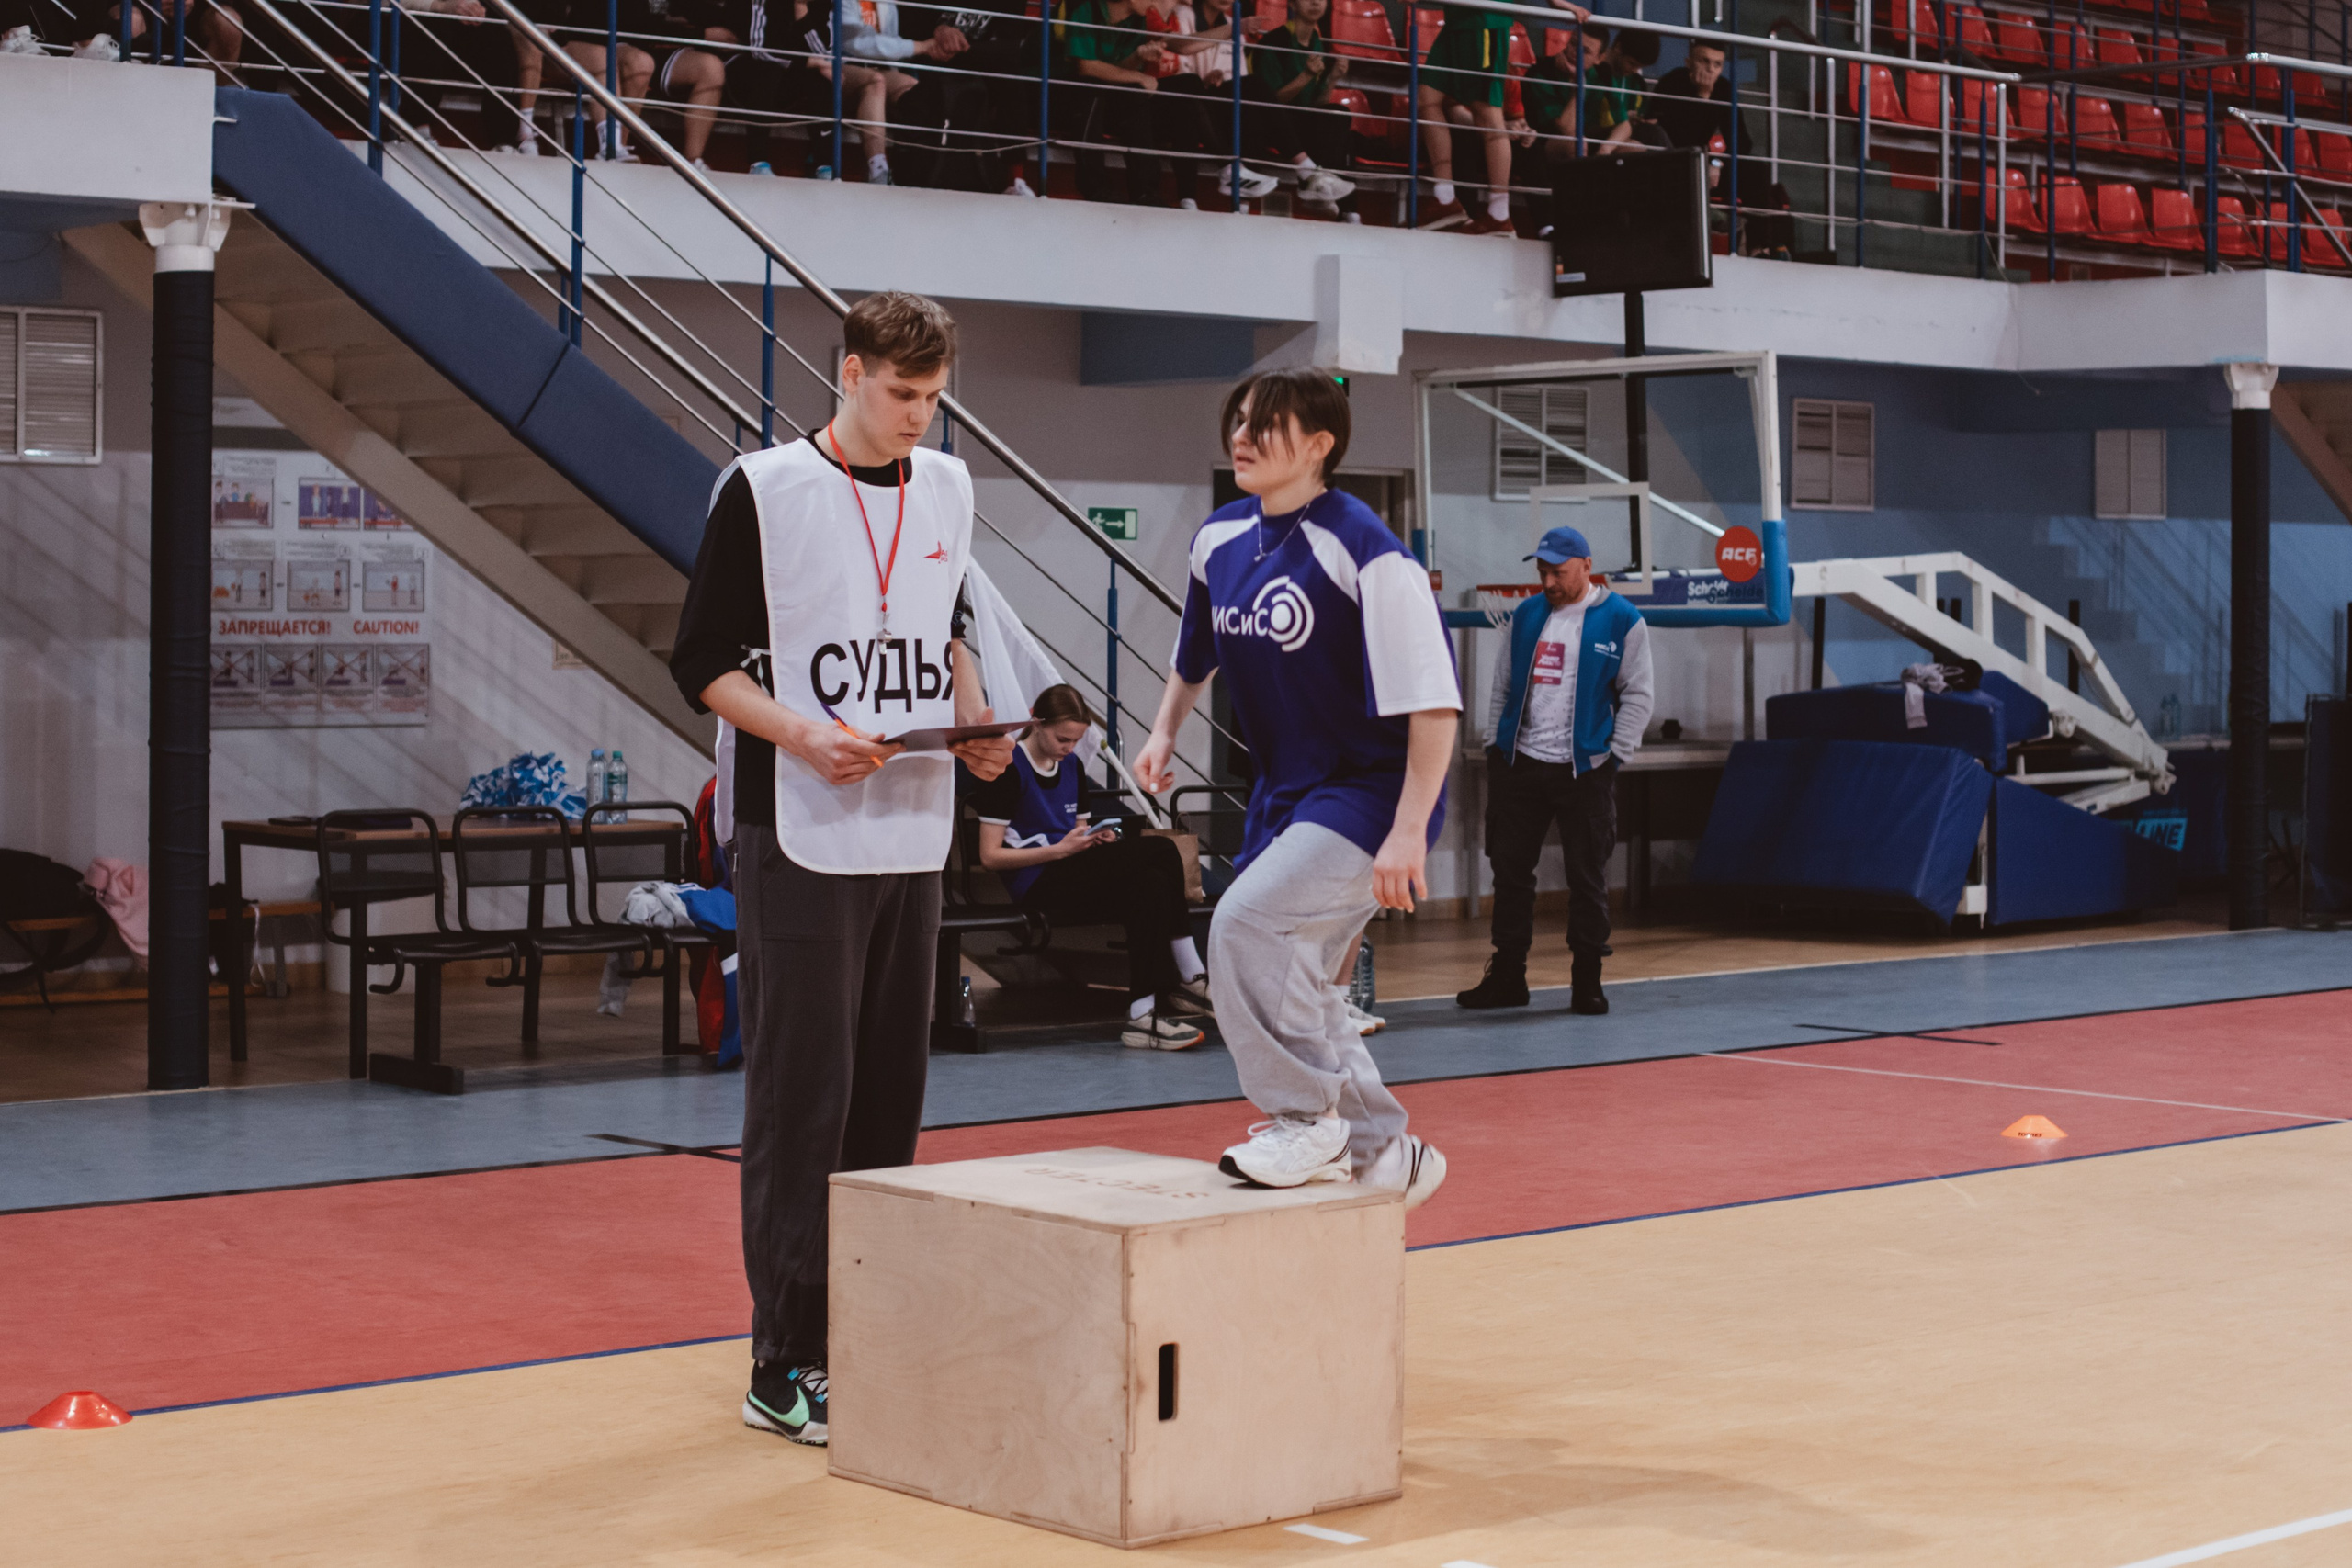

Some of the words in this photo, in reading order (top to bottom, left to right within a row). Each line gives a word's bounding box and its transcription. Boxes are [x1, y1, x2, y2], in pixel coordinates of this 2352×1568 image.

[218, 619, 331, 637] ЗАПРЕЩАЕТСЯ!
[353, 619, 419, 635] CAUTION!
[1211, 605, 1269, 637] ИСиС
